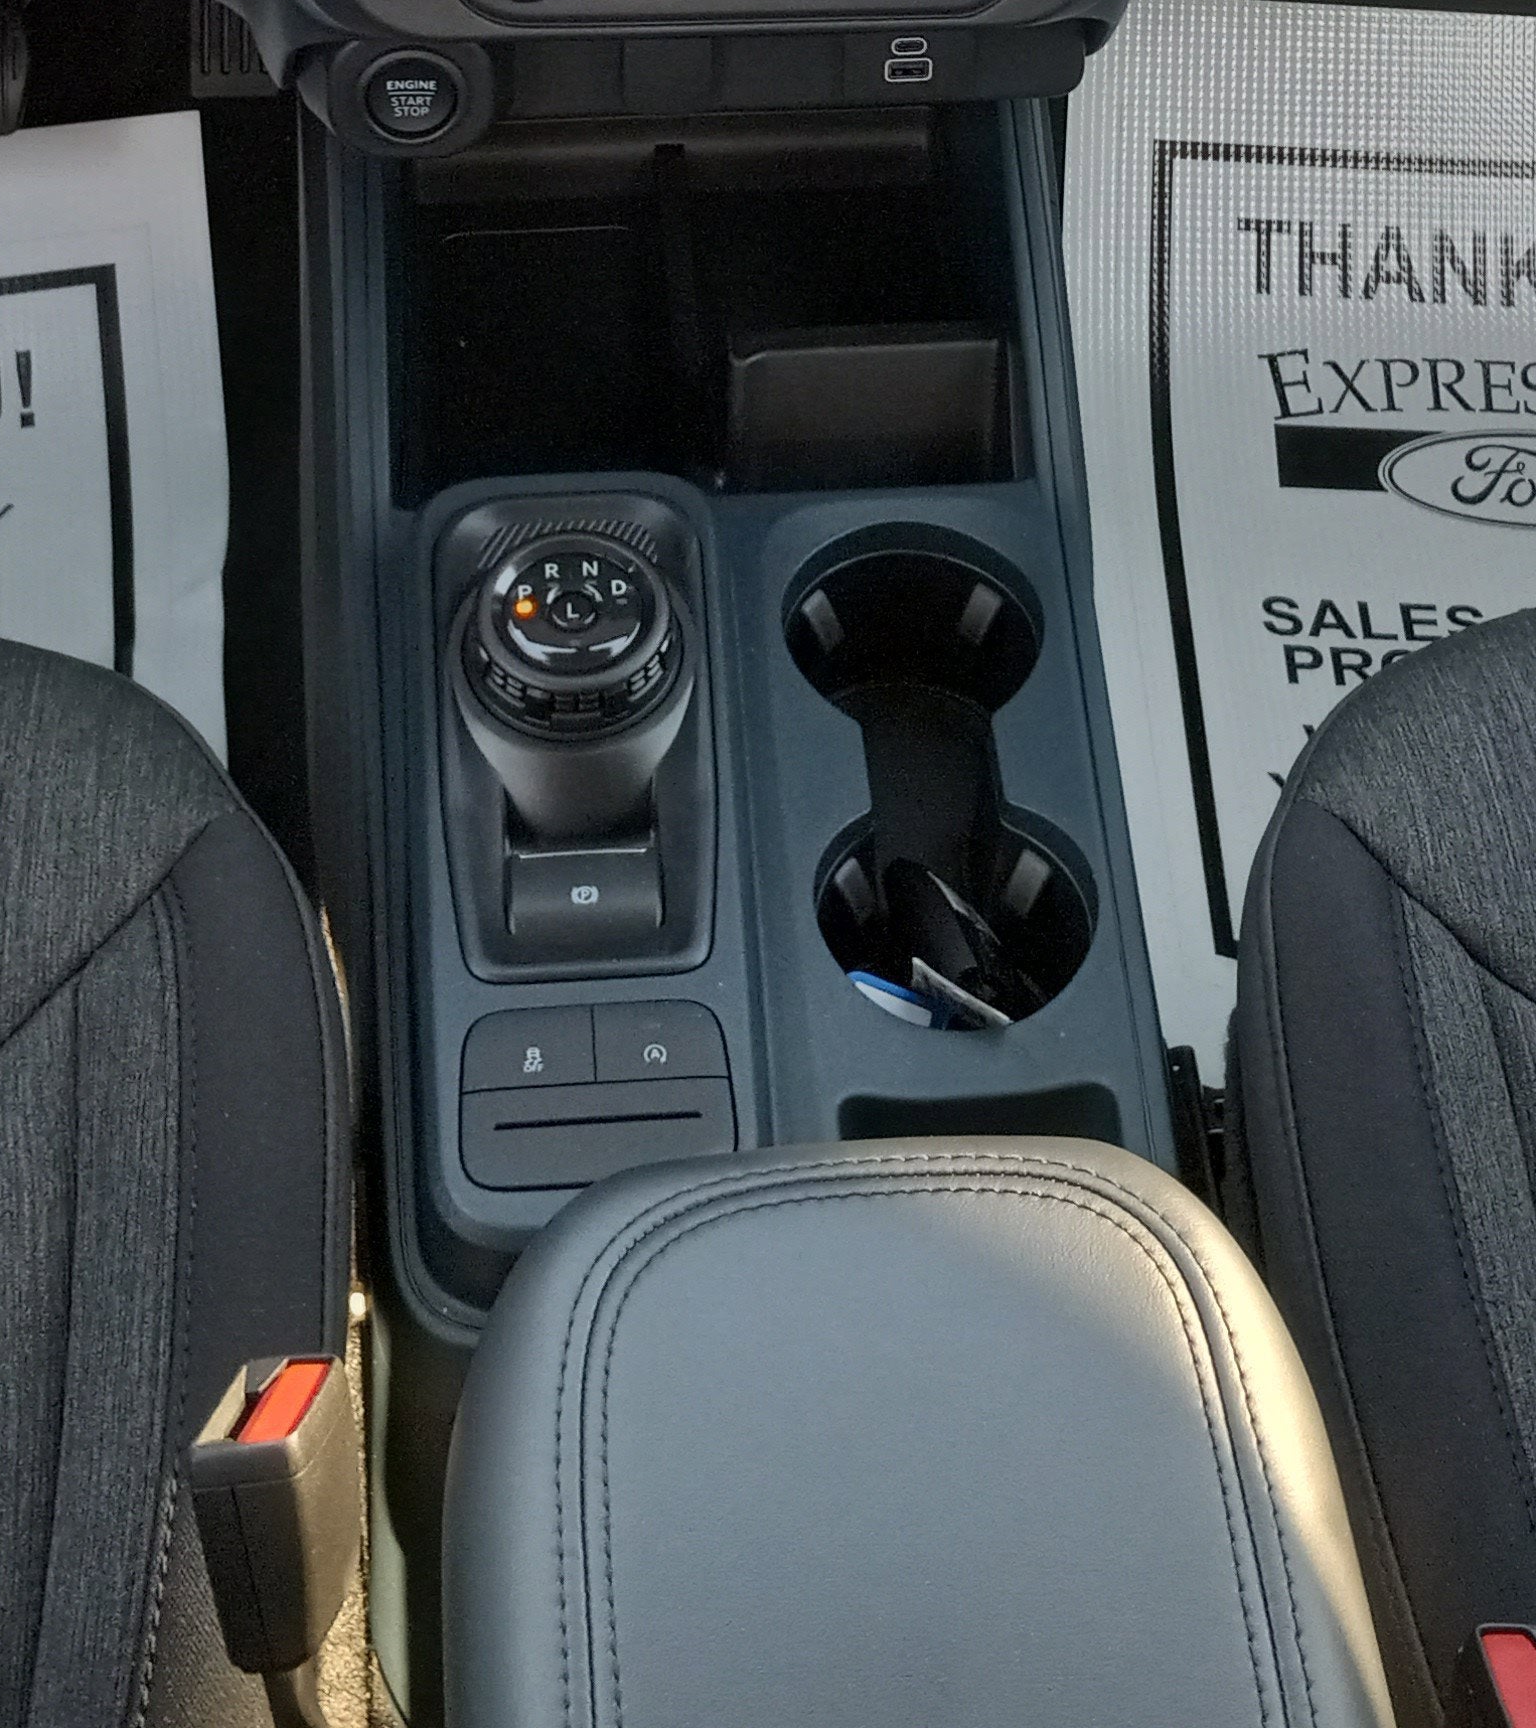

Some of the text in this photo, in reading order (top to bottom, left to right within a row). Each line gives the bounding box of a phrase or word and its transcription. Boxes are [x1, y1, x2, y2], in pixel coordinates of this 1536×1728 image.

[386, 80, 437, 91] ENGINE
[390, 96, 433, 107] START
[393, 106, 430, 117] STOP
[518, 561, 627, 600] P R N D
[566, 602, 580, 618] L
